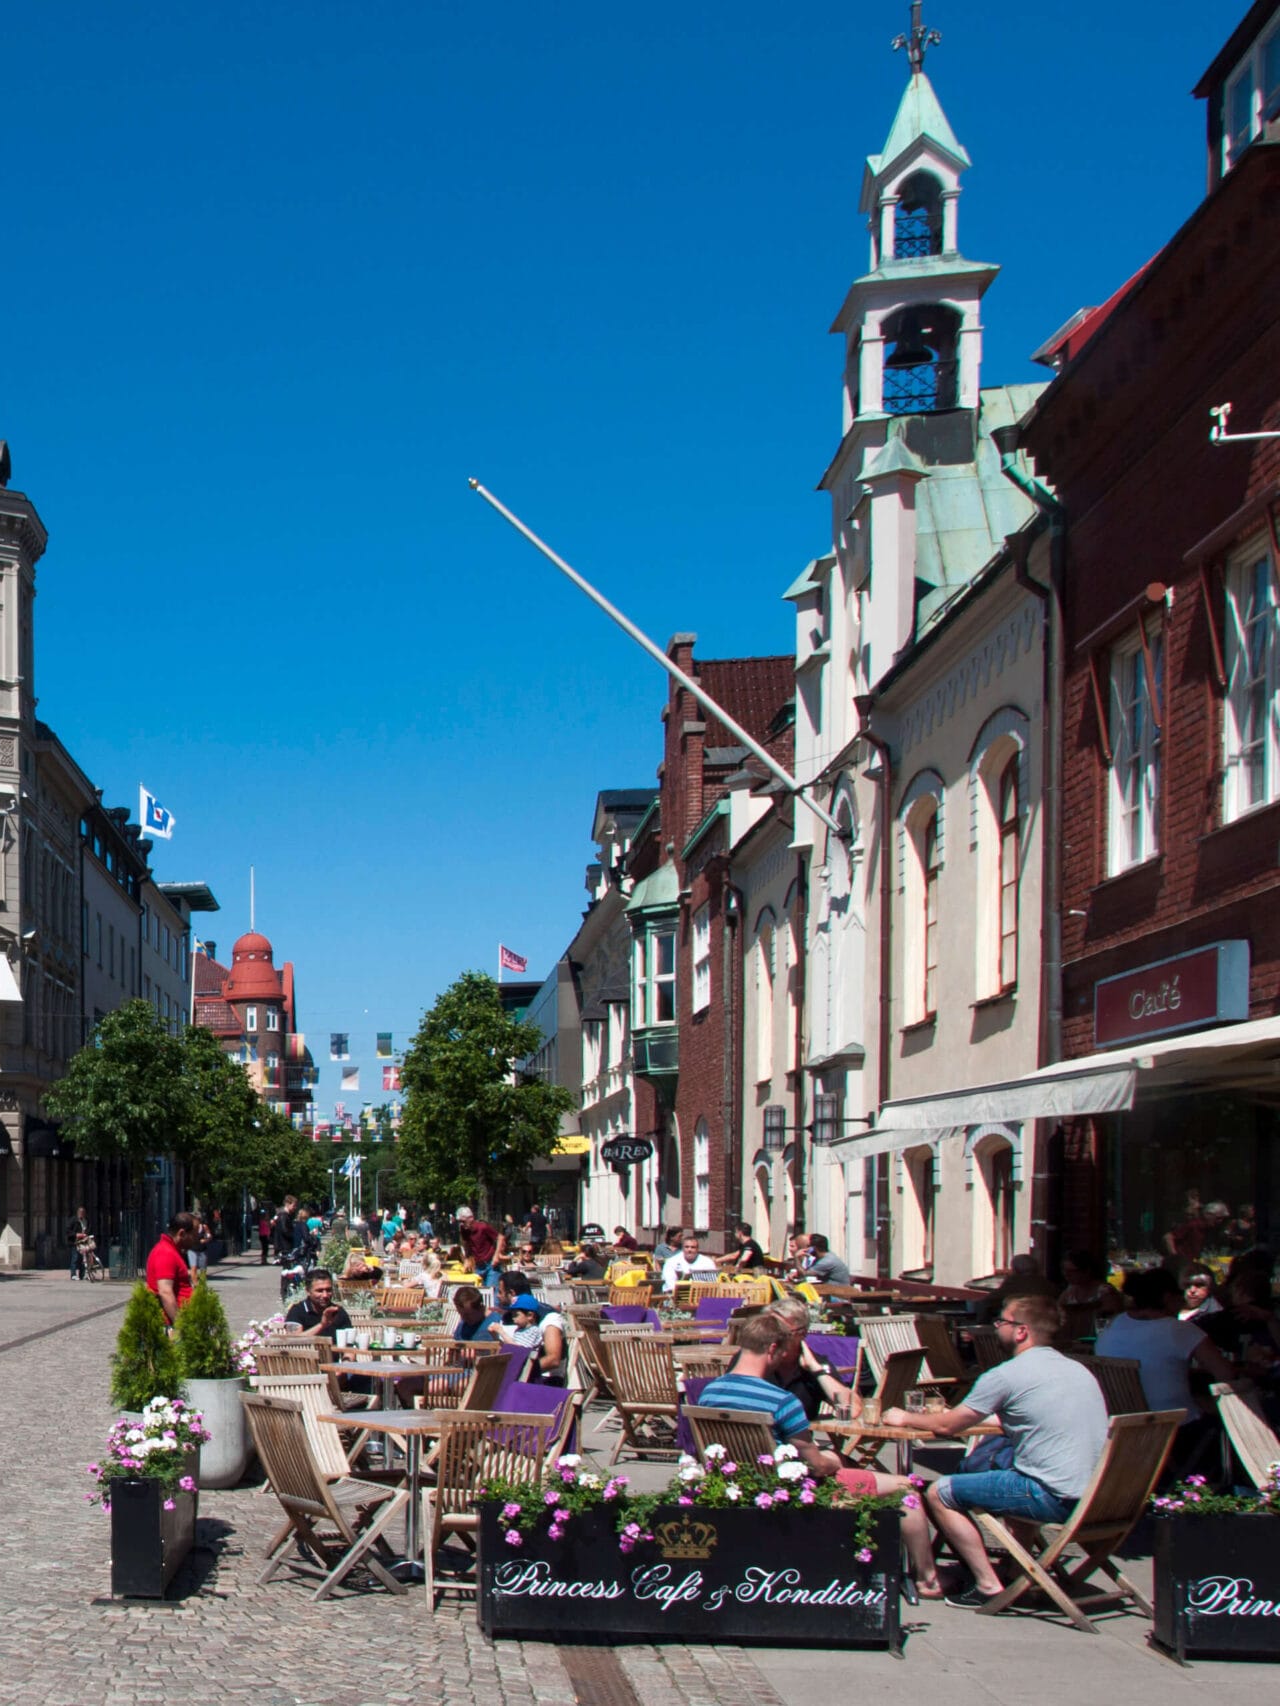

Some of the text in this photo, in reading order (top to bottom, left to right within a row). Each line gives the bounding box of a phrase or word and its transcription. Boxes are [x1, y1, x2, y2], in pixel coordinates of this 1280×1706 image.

[1129, 974, 1182, 1021] Café
[603, 1145, 650, 1160] BAREN
[491, 1559, 888, 1611] Princess Café & Konditori
